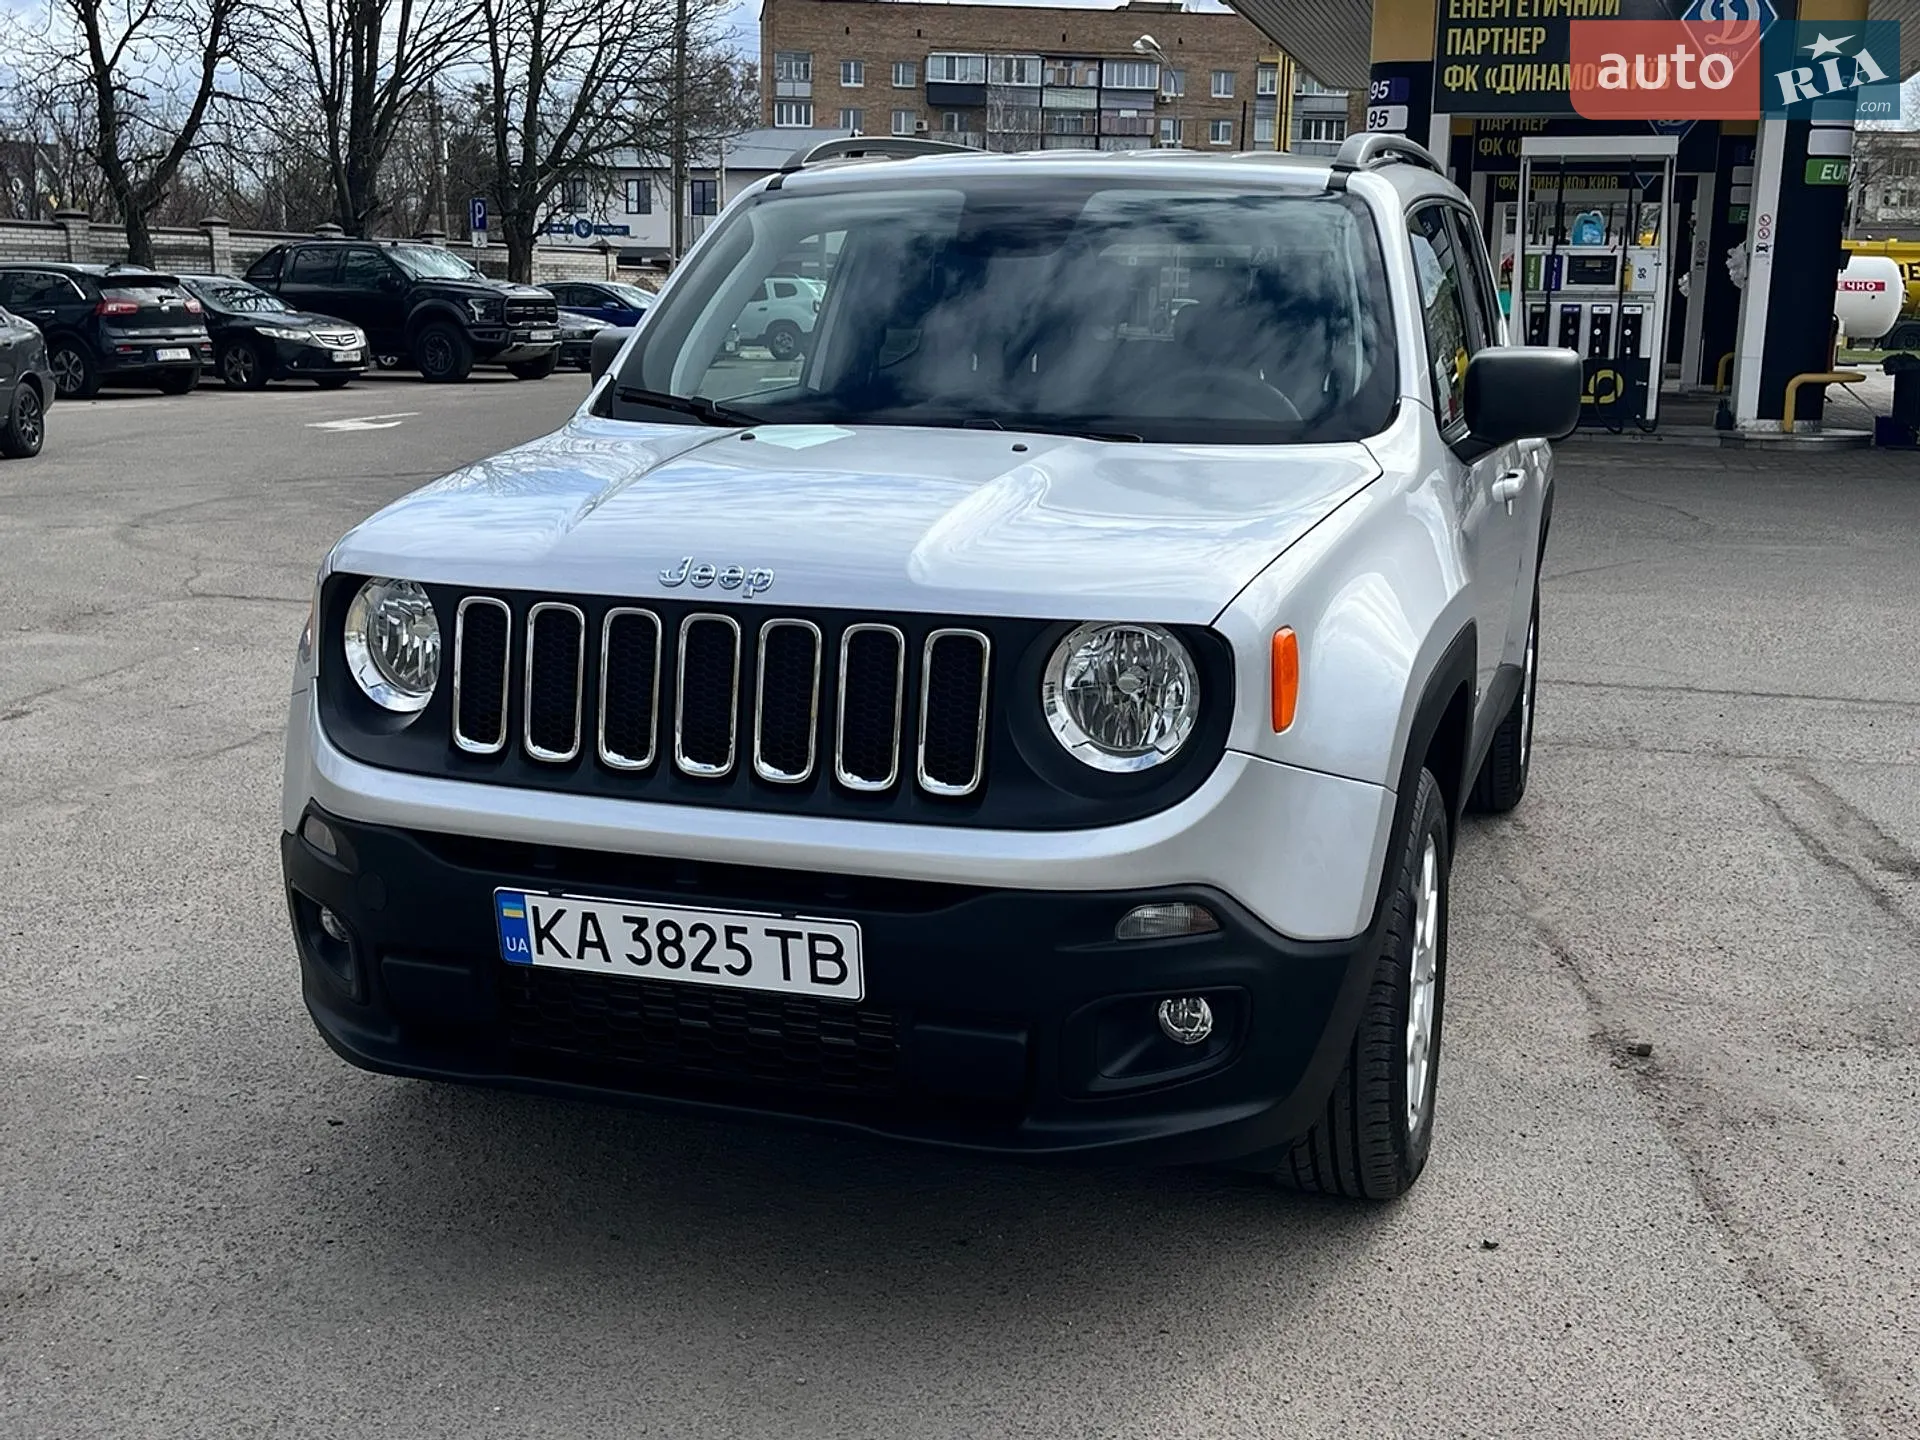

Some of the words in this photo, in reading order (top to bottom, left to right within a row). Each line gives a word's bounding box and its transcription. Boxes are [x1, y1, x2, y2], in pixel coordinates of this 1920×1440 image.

[1446, 27, 1547, 55] ПАРТНЕР
[1371, 80, 1390, 100] 95
[1444, 65, 1480, 92] ФК
[1369, 110, 1389, 129] 95
[1479, 137, 1503, 156] ФК
[1499, 176, 1517, 190] ФК
[475, 202, 484, 228] P
[659, 556, 775, 598] Jeep
[506, 936, 529, 953] UA
[531, 905, 612, 963] KA
[622, 915, 753, 977] 3825
[764, 928, 849, 986] TB
